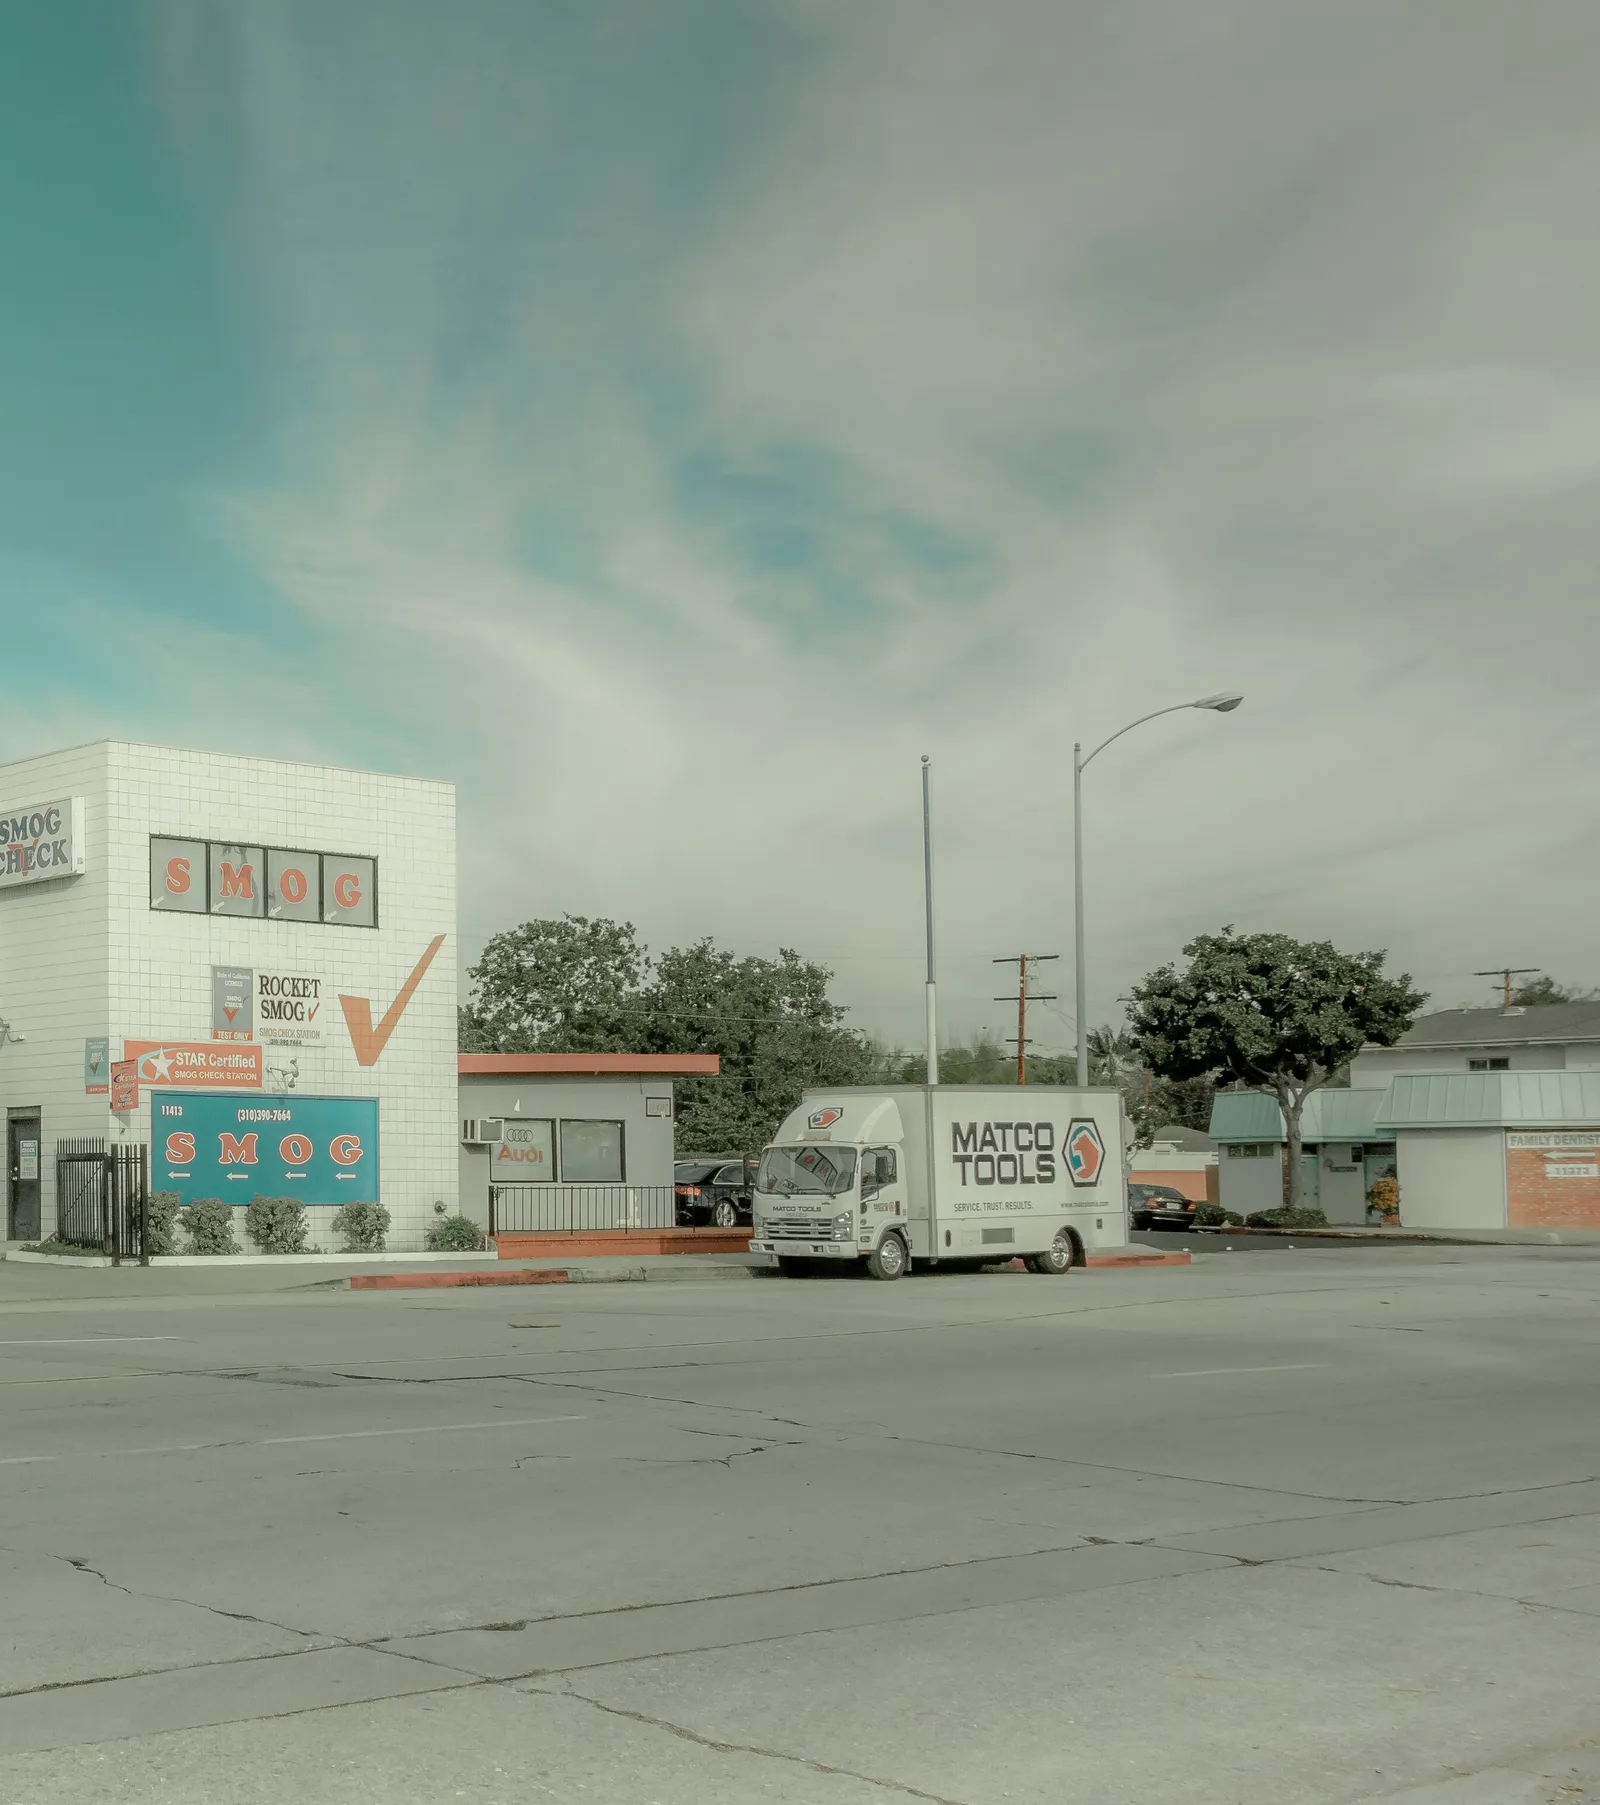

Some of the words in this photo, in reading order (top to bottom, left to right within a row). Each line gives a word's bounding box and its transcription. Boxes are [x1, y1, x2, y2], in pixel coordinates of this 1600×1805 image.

[166, 857, 362, 909] SMOG
[259, 975, 321, 998] ROCKET
[261, 1000, 305, 1021] SMOG
[217, 1030, 232, 1039] TEST
[233, 1031, 249, 1040] ONLY
[259, 1028, 277, 1038] SMOG
[278, 1029, 295, 1039] CHECK
[296, 1030, 320, 1039] STATION
[176, 1052, 206, 1066] STAR
[208, 1052, 256, 1068] Certified
[174, 1070, 198, 1079] SMOG
[199, 1071, 226, 1080] CHECK
[226, 1071, 257, 1081] STATION
[161, 1105, 183, 1116] 11413
[237, 1109, 291, 1123] (310)390-7664
[952, 1121, 1055, 1153] MATCO
[1510, 1134, 1551, 1146] FAMILY
[166, 1131, 364, 1165] SMOG
[497, 1144, 544, 1164] Audi
[952, 1153, 1056, 1186] TOOLS
[954, 1202, 982, 1212] SERVICE.
[983, 1202, 1004, 1211] TRUST.
[1005, 1201, 1034, 1210] RESULTS.
